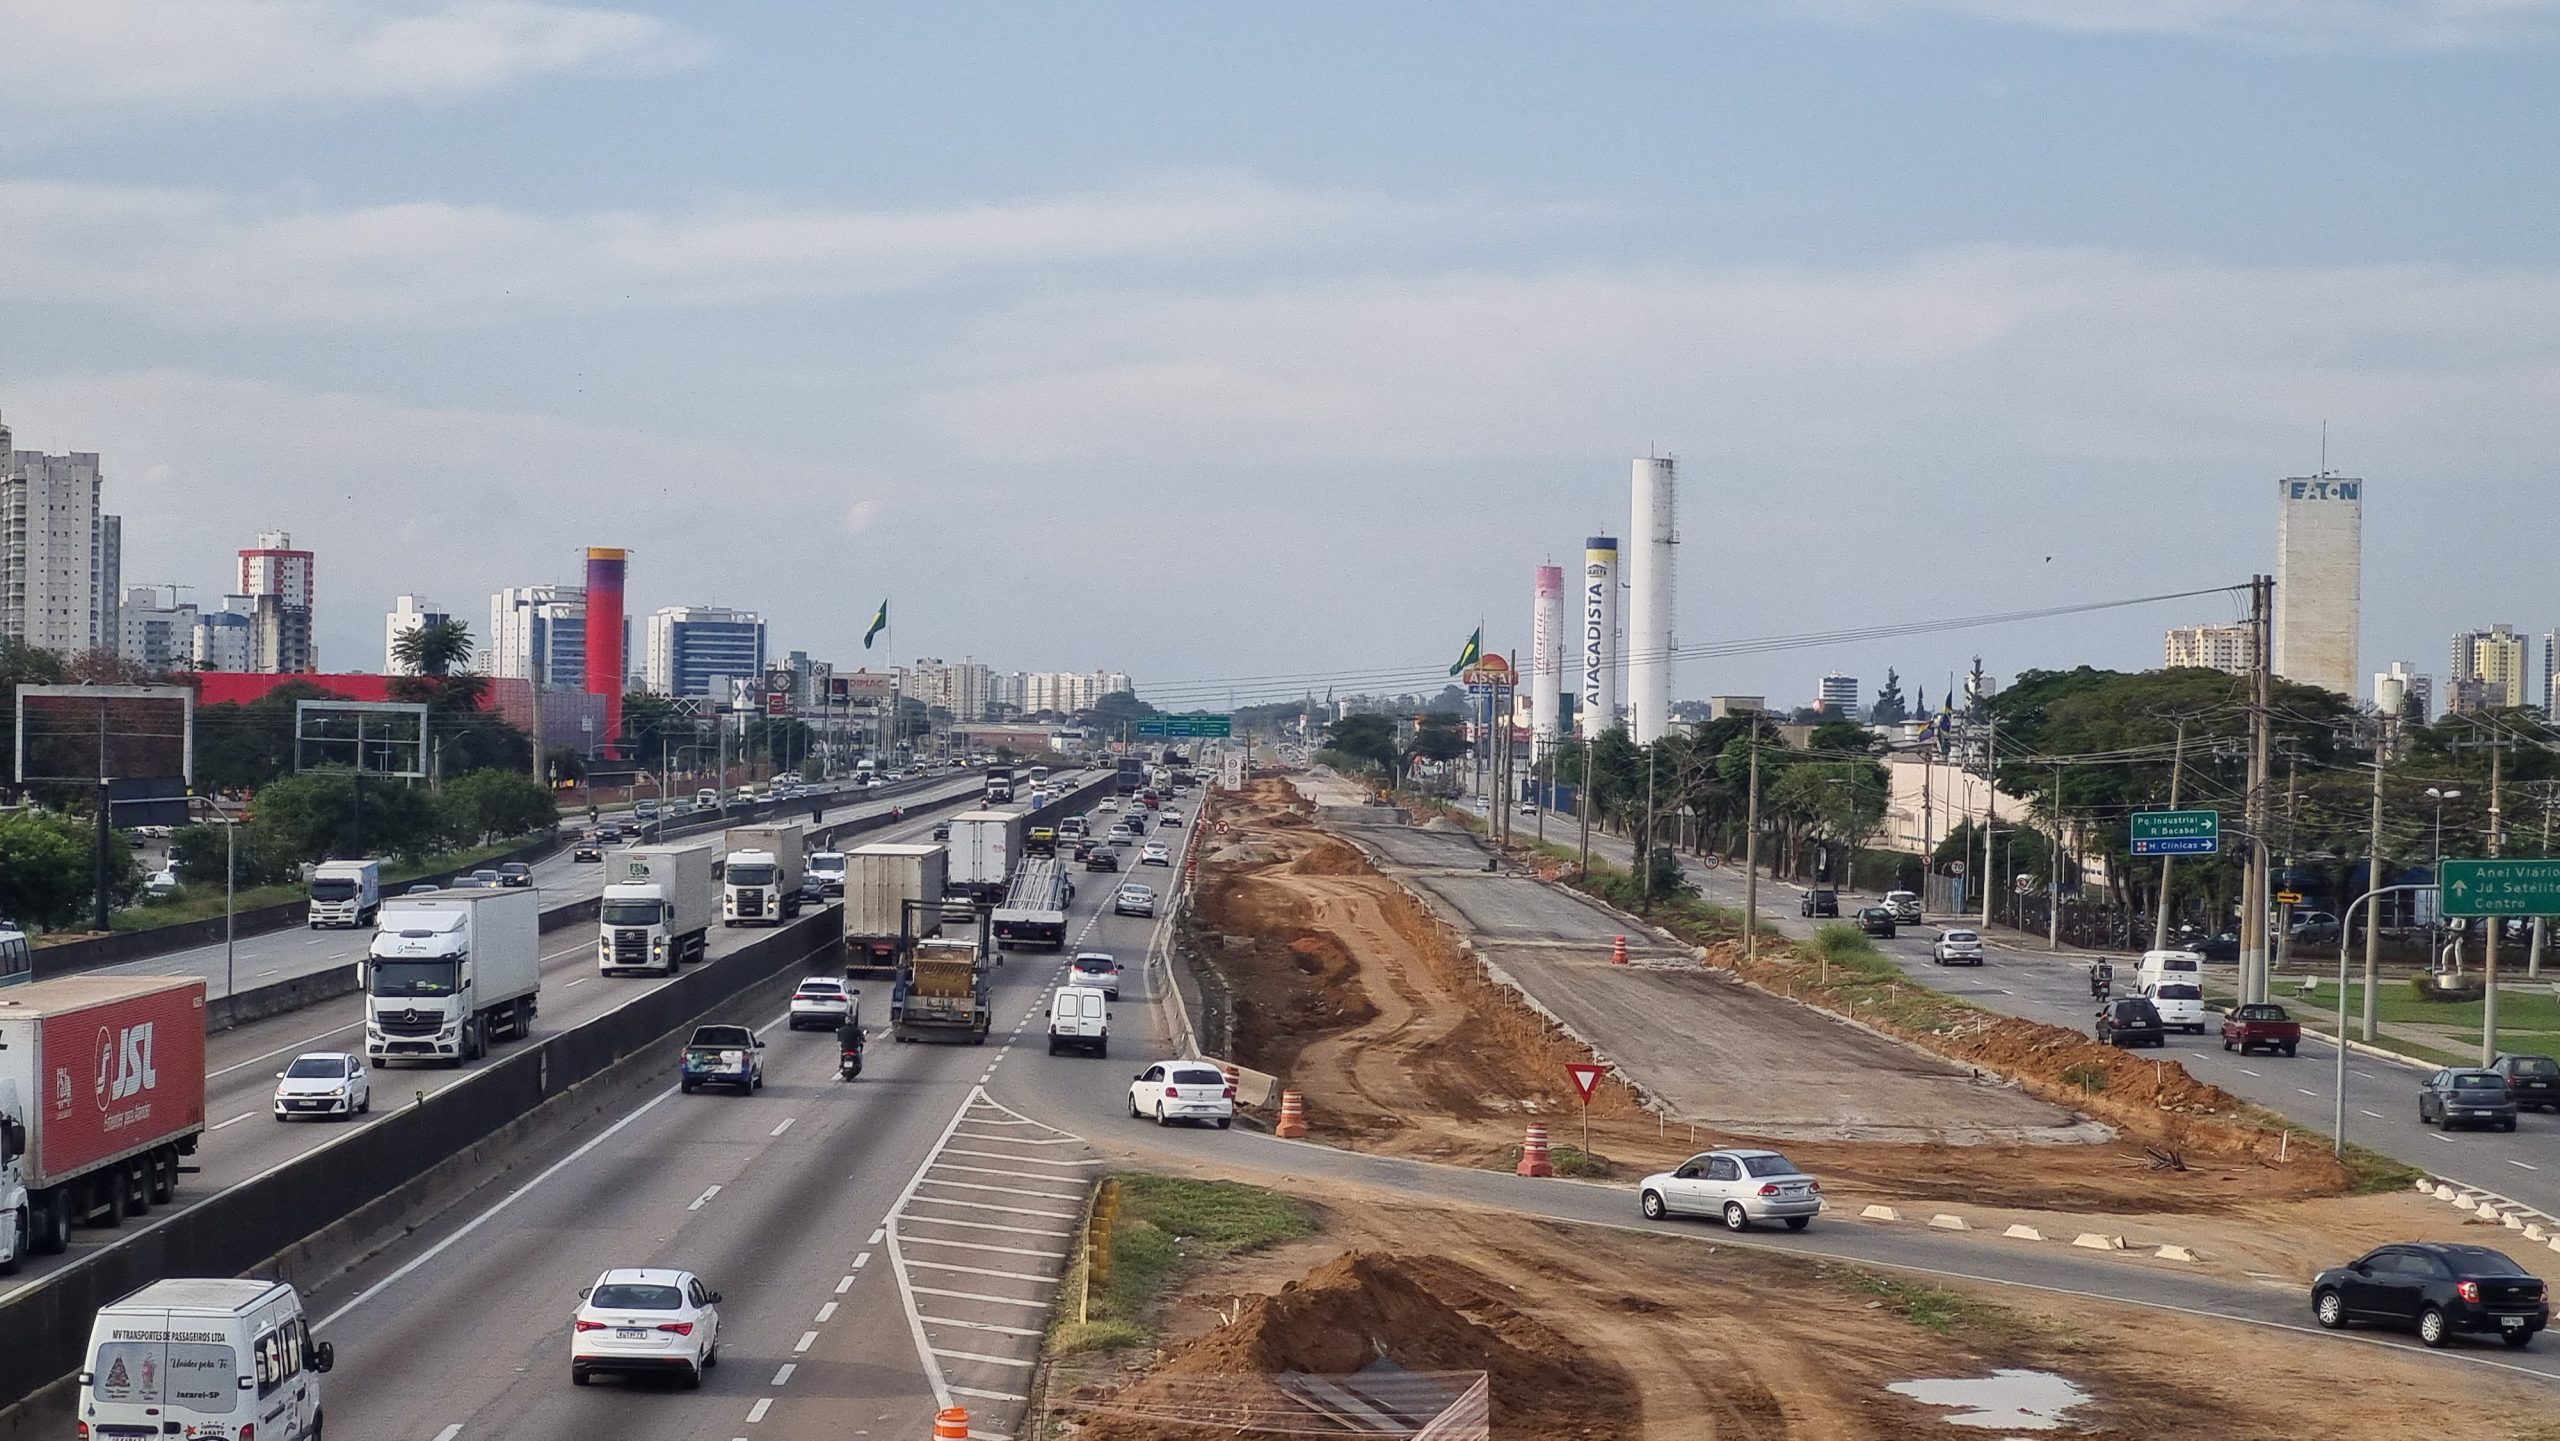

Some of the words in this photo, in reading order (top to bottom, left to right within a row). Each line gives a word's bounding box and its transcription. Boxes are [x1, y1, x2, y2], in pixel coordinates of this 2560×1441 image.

[2291, 482, 2358, 500] EATON
[1586, 583, 1603, 707] ATACADISTA
[2153, 816, 2198, 825] Industrial
[2161, 827, 2198, 835] Bacabal
[1707, 857, 1716, 865] 70
[2476, 867, 2509, 878] Anel
[2515, 866, 2560, 877] Viário
[2475, 898, 2526, 909] Centro
[112, 1021, 156, 1101] JSL
[112, 1329, 122, 1340] MV
[123, 1329, 163, 1341] TRANSPORTES
[163, 1331, 170, 1341] DE
[171, 1331, 211, 1342] PASSAGEIROS
[211, 1332, 226, 1343] LTDA
